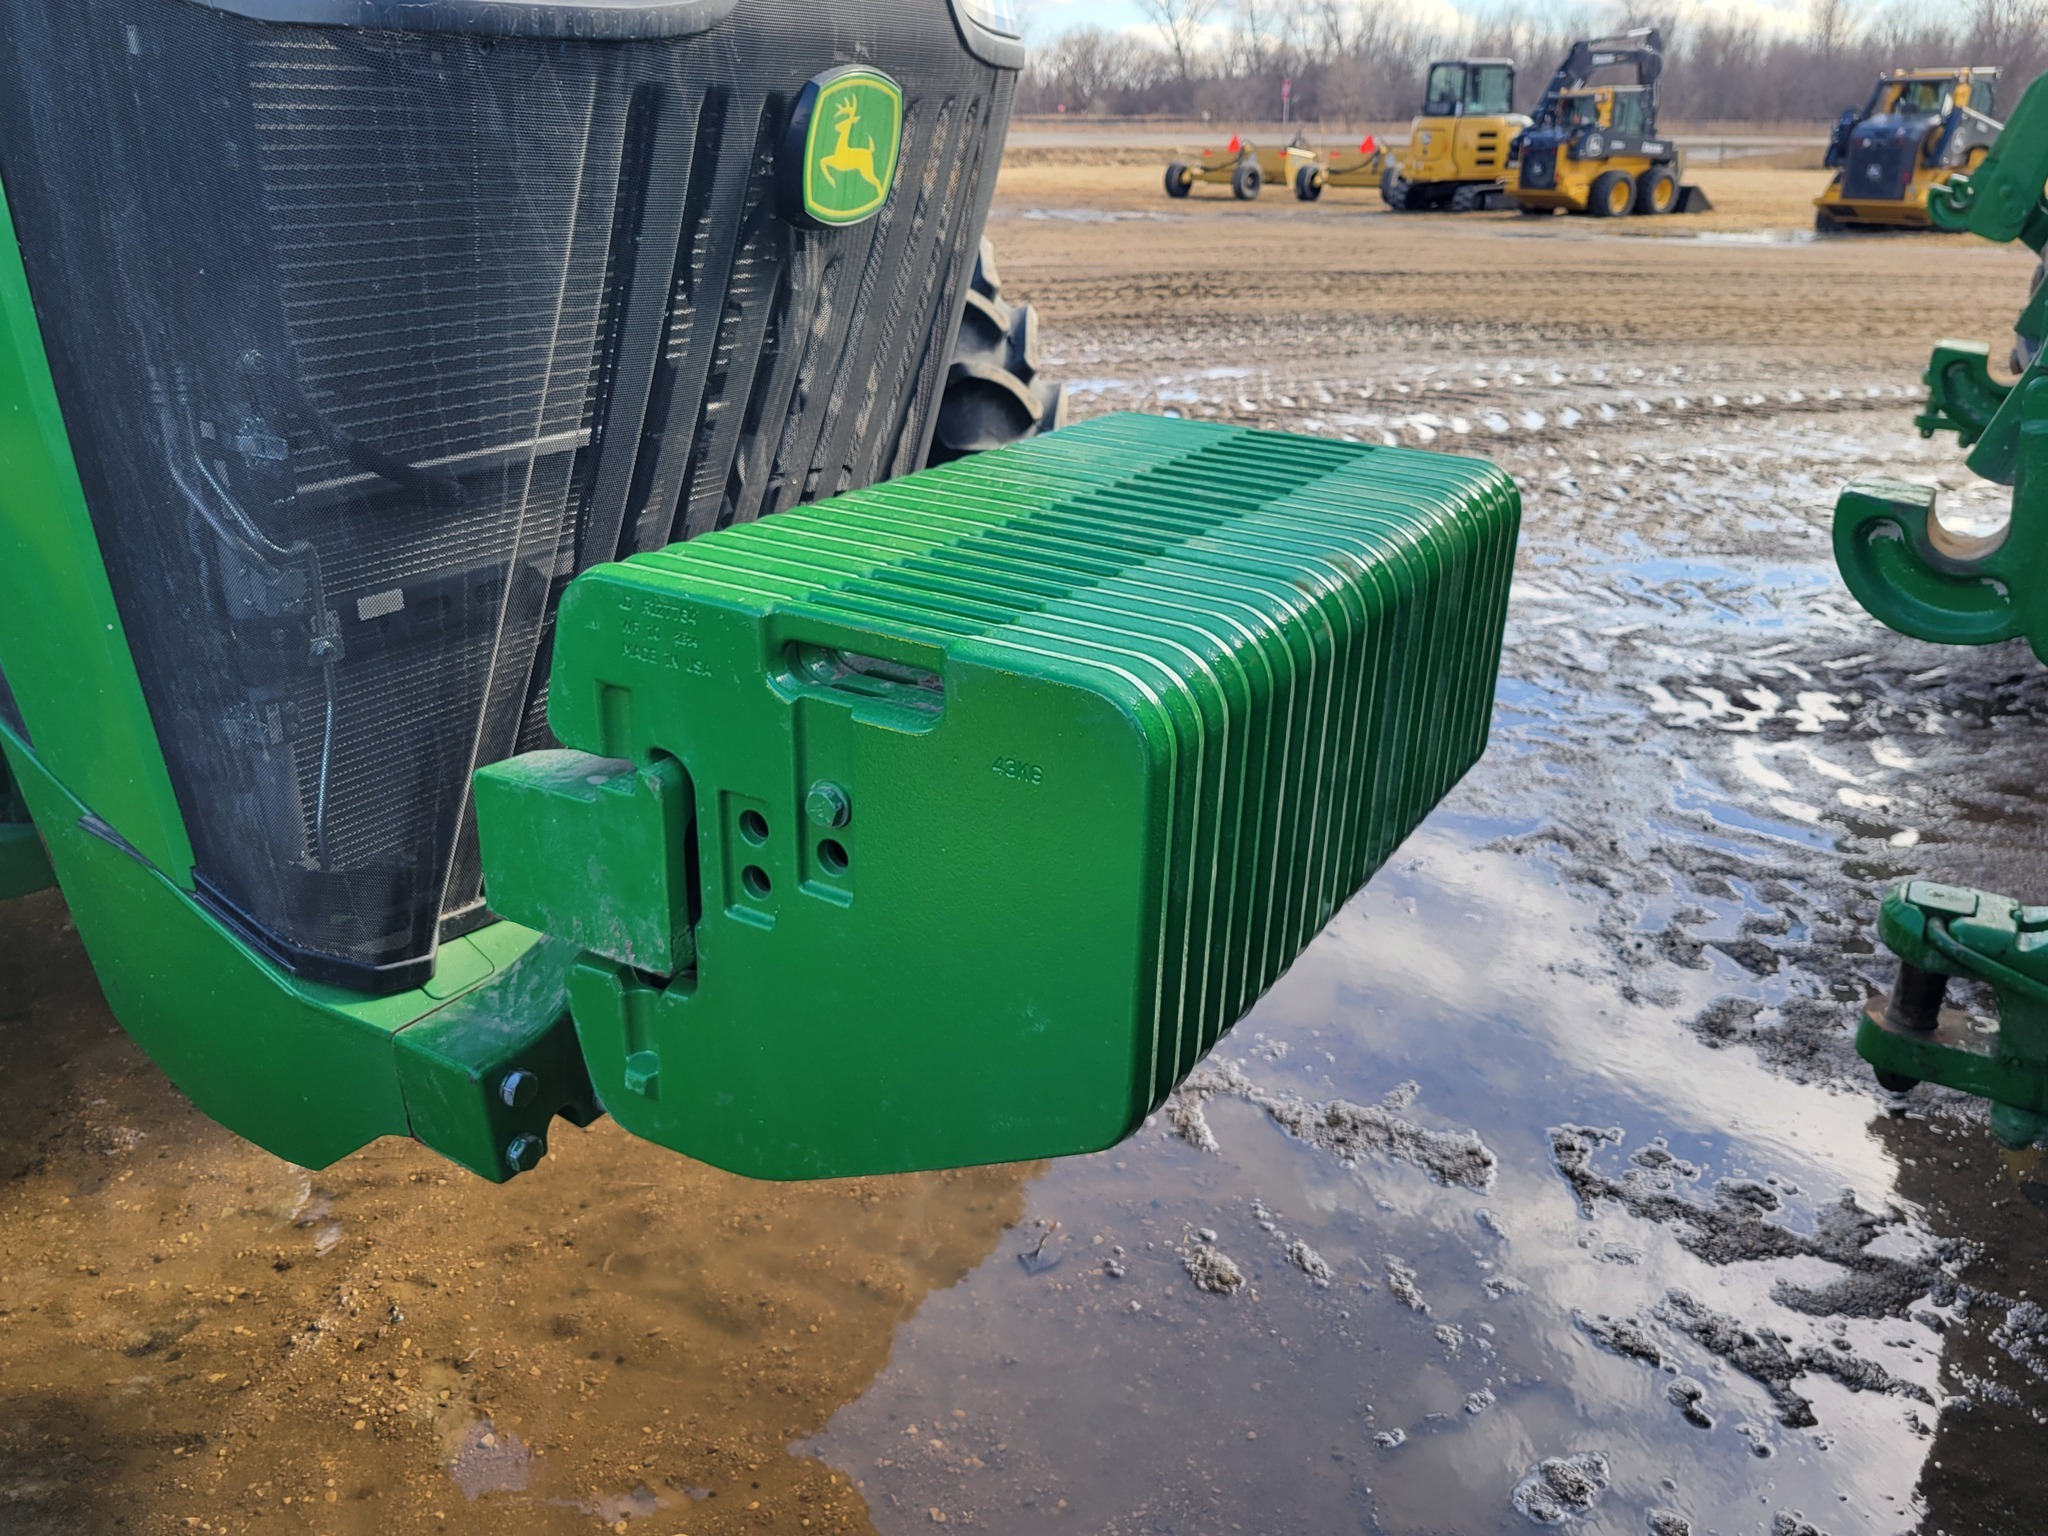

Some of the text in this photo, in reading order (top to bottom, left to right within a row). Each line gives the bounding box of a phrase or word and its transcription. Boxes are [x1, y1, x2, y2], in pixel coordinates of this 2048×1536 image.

[621, 643, 713, 678] MADE IN USA
